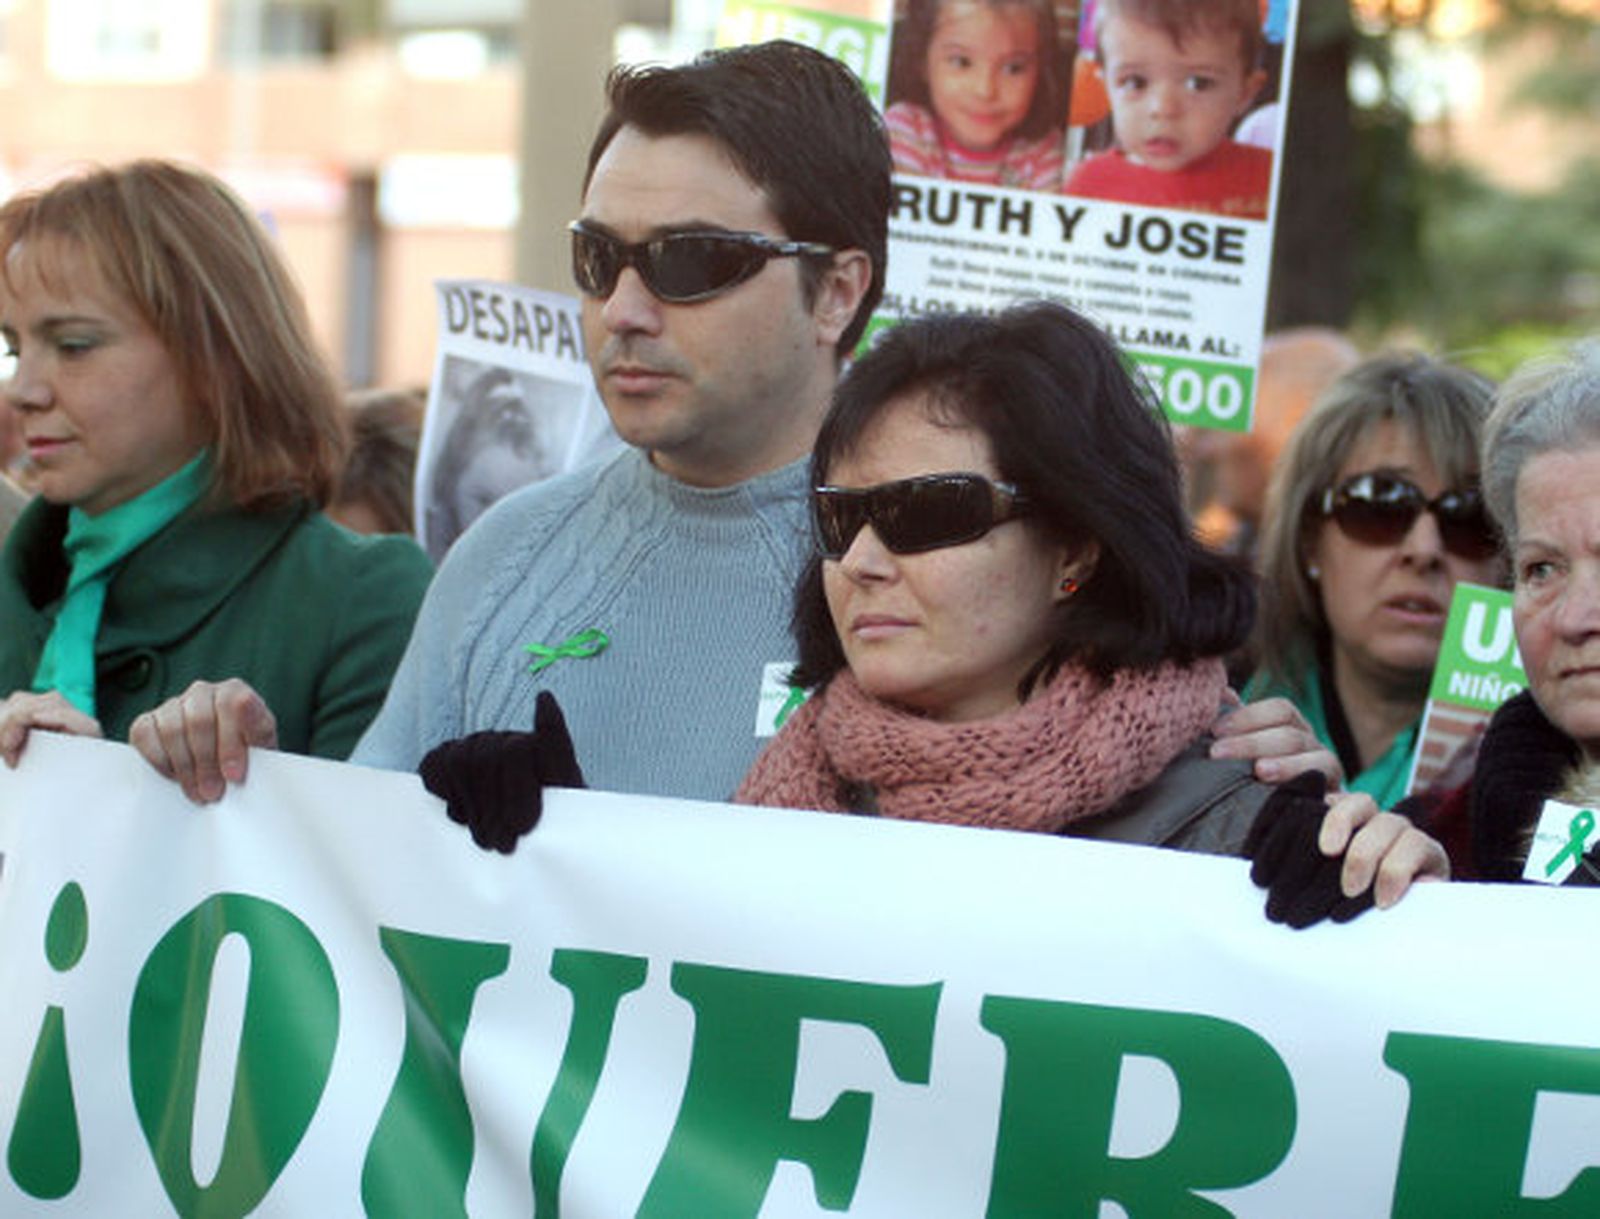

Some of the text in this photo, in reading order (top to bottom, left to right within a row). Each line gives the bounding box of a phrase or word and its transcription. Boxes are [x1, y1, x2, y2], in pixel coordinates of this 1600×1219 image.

[889, 184, 1247, 265] RUTH Y JOSE
[1201, 336, 1242, 358] AL:
